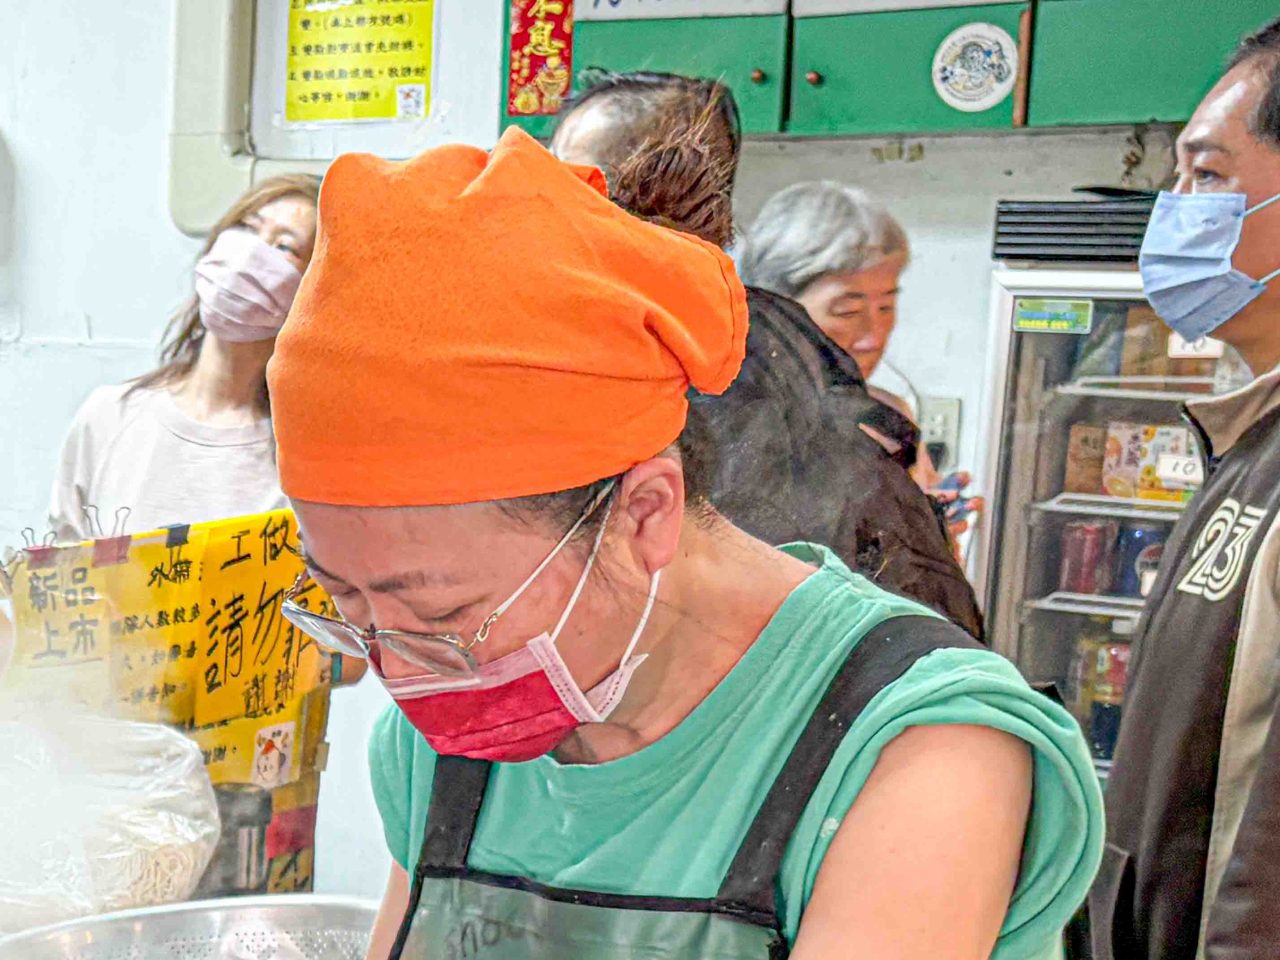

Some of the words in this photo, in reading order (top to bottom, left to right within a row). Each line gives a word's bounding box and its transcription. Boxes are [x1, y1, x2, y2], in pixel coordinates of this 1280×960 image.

[1177, 497, 1268, 601] 23
[28, 566, 96, 614] 新品
[32, 612, 98, 661] 上市
